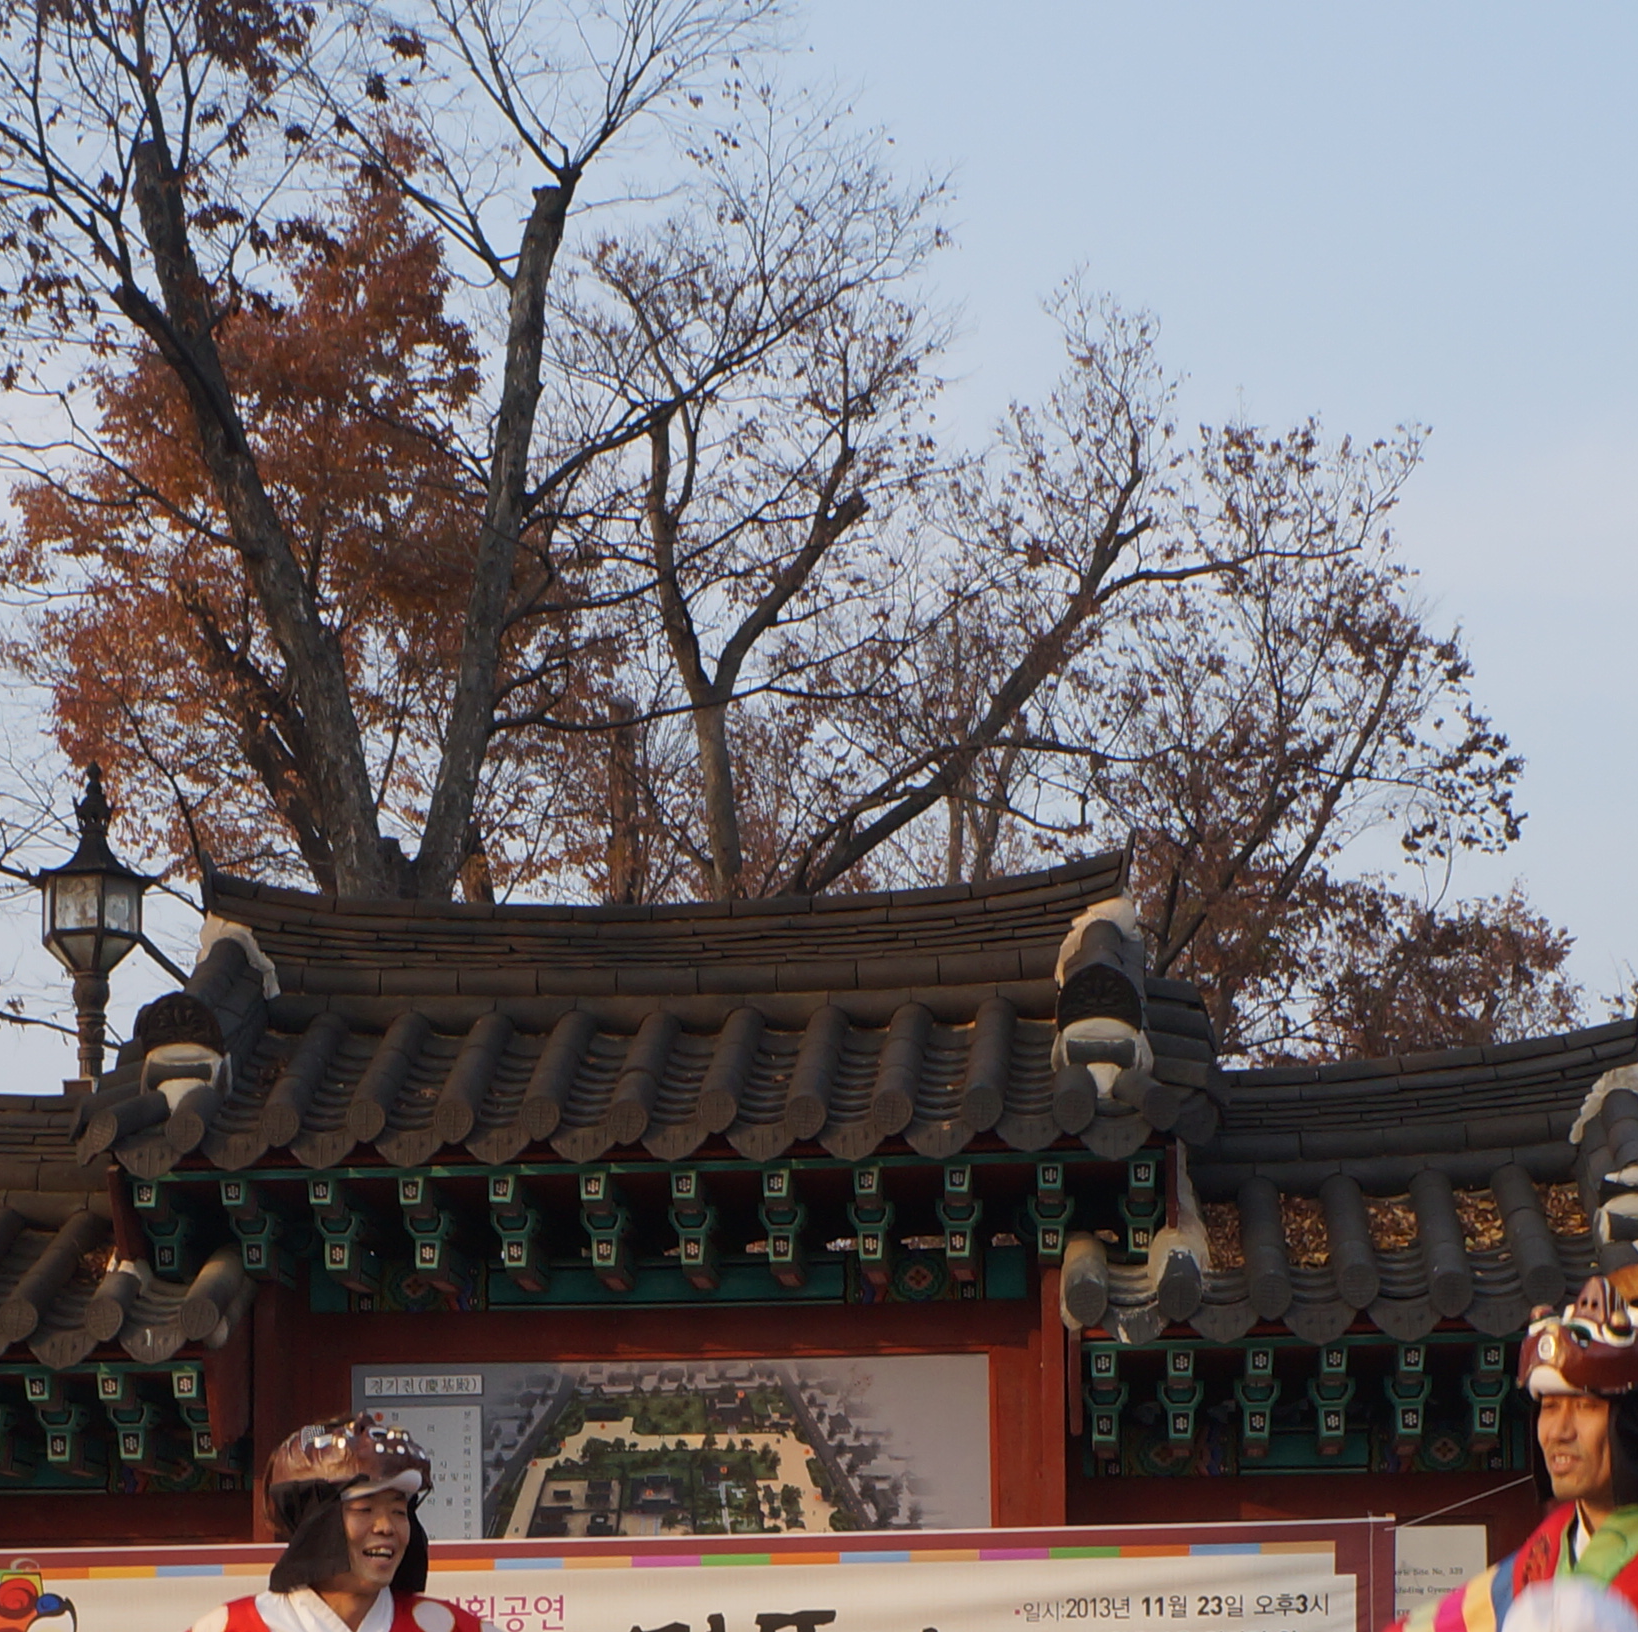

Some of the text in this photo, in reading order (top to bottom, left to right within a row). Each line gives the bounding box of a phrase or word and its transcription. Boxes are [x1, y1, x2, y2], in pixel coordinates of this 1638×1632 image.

[1141, 1595, 1187, 1618] 11월
[1197, 1594, 1243, 1618] 23일
[1253, 1593, 1329, 1617] 오후3시
